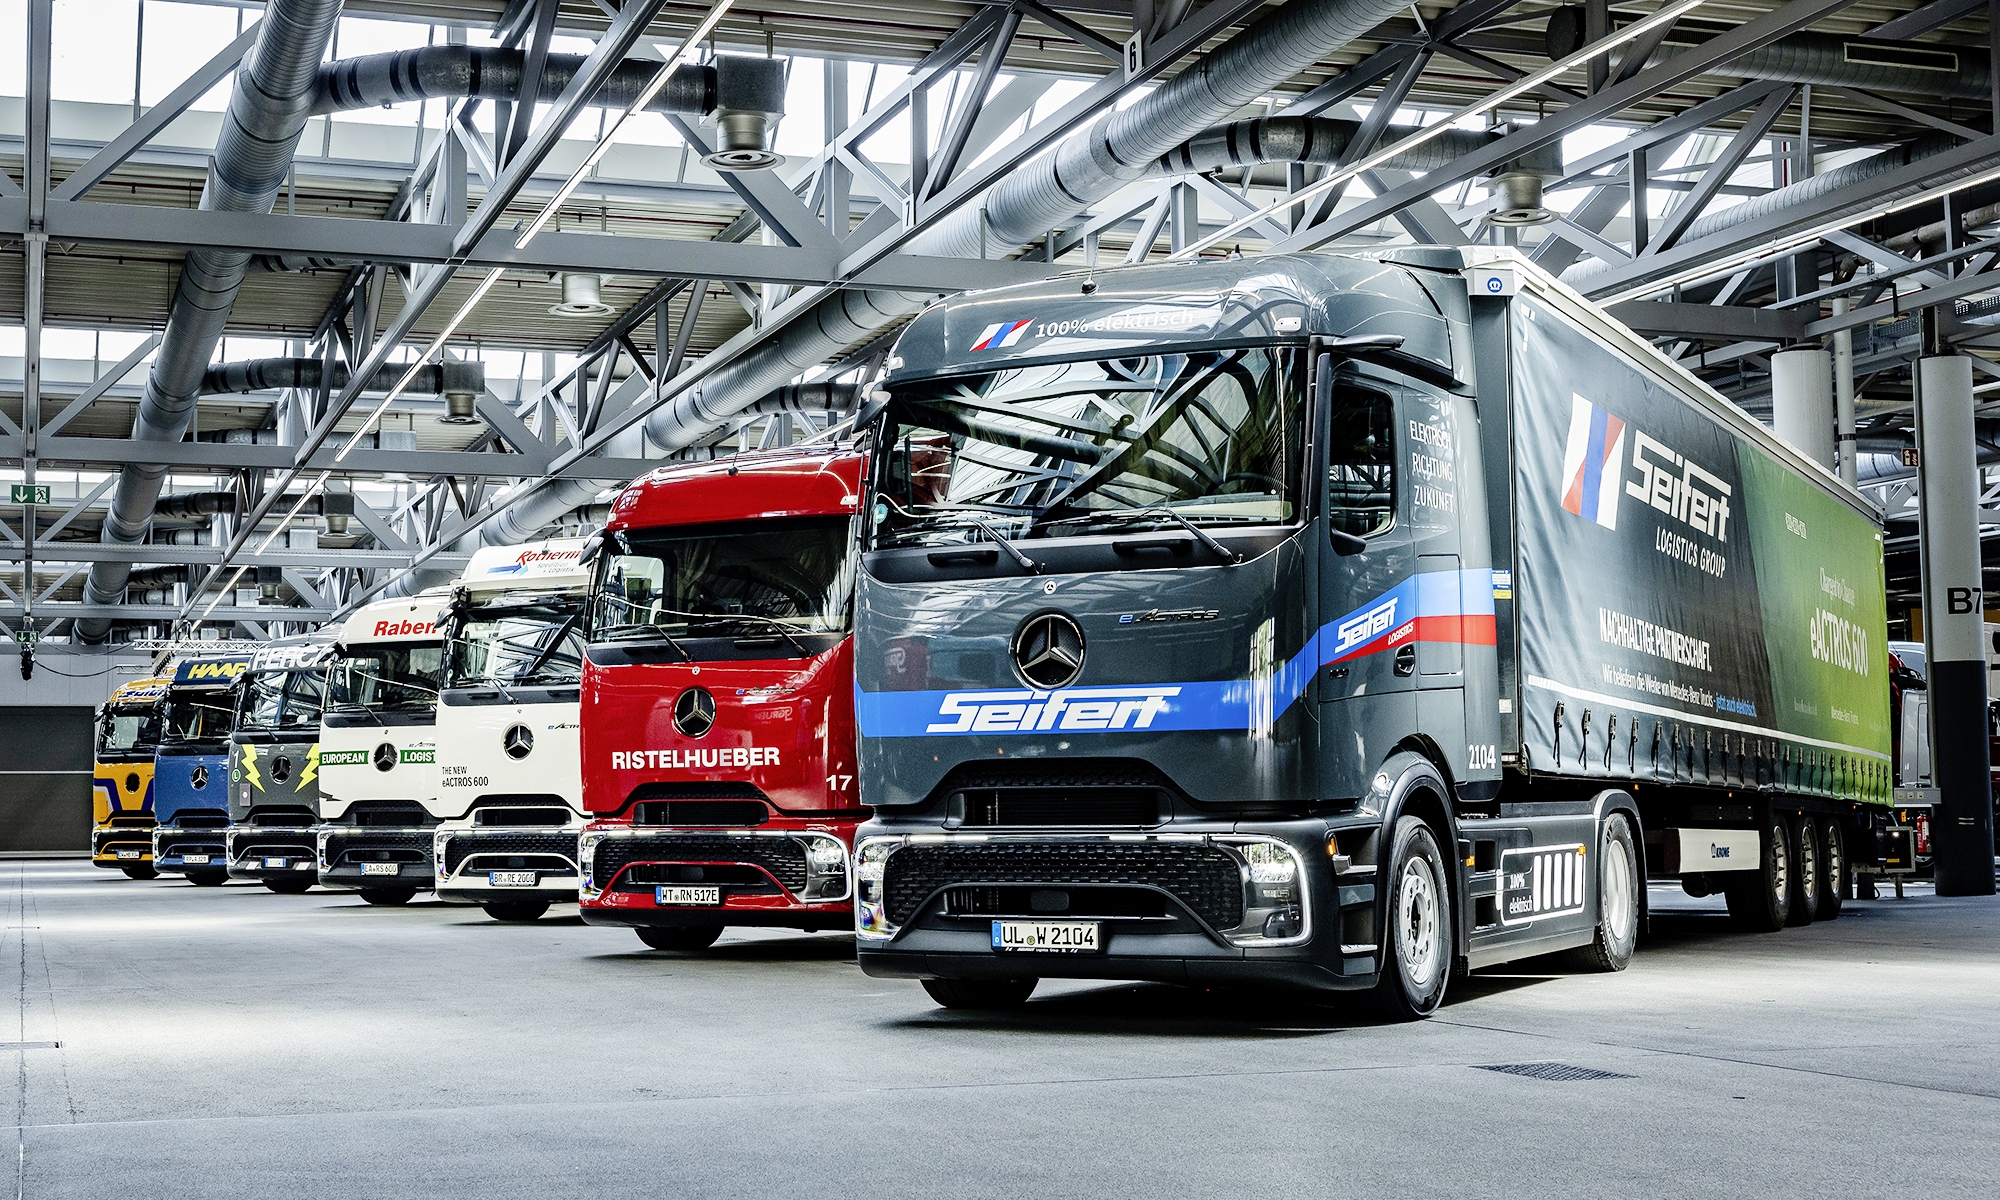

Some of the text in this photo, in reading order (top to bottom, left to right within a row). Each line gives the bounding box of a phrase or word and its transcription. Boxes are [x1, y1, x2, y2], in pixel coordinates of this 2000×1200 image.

[1129, 41, 1137, 73] 6
[1035, 310, 1194, 338] 100% elektrisch
[1412, 452, 1453, 482] RICHTUNG
[1625, 429, 1732, 543] Seifert
[1655, 526, 1726, 578] LOGISTICS GROUP
[1947, 586, 1982, 615] B7
[1334, 597, 1399, 654] Seifert
[1387, 621, 1415, 646] LOGISTICS
[1599, 606, 1656, 657] NACHHALTIGE
[1810, 607, 1869, 677] eACTROS 600
[926, 686, 1183, 733] Seifert
[321, 752, 365, 765] EUROPEAN
[611, 747, 780, 770] RISTELHUEBER
[1468, 743, 1497, 770] 2104
[442, 766, 468, 775] THE NEW
[442, 776, 489, 787] eACTROS 600
[825, 774, 853, 791] 17
[508, 873, 515, 883] RE
[1510, 872, 1525, 889] 100%
[680, 888, 692, 901] RN
[694, 888, 717, 901] 517E
[1510, 894, 1533, 915] elektrisch
[1002, 926, 1024, 944] UL
[1036, 926, 1047, 944] W
[1051, 927, 1094, 945] 2104
